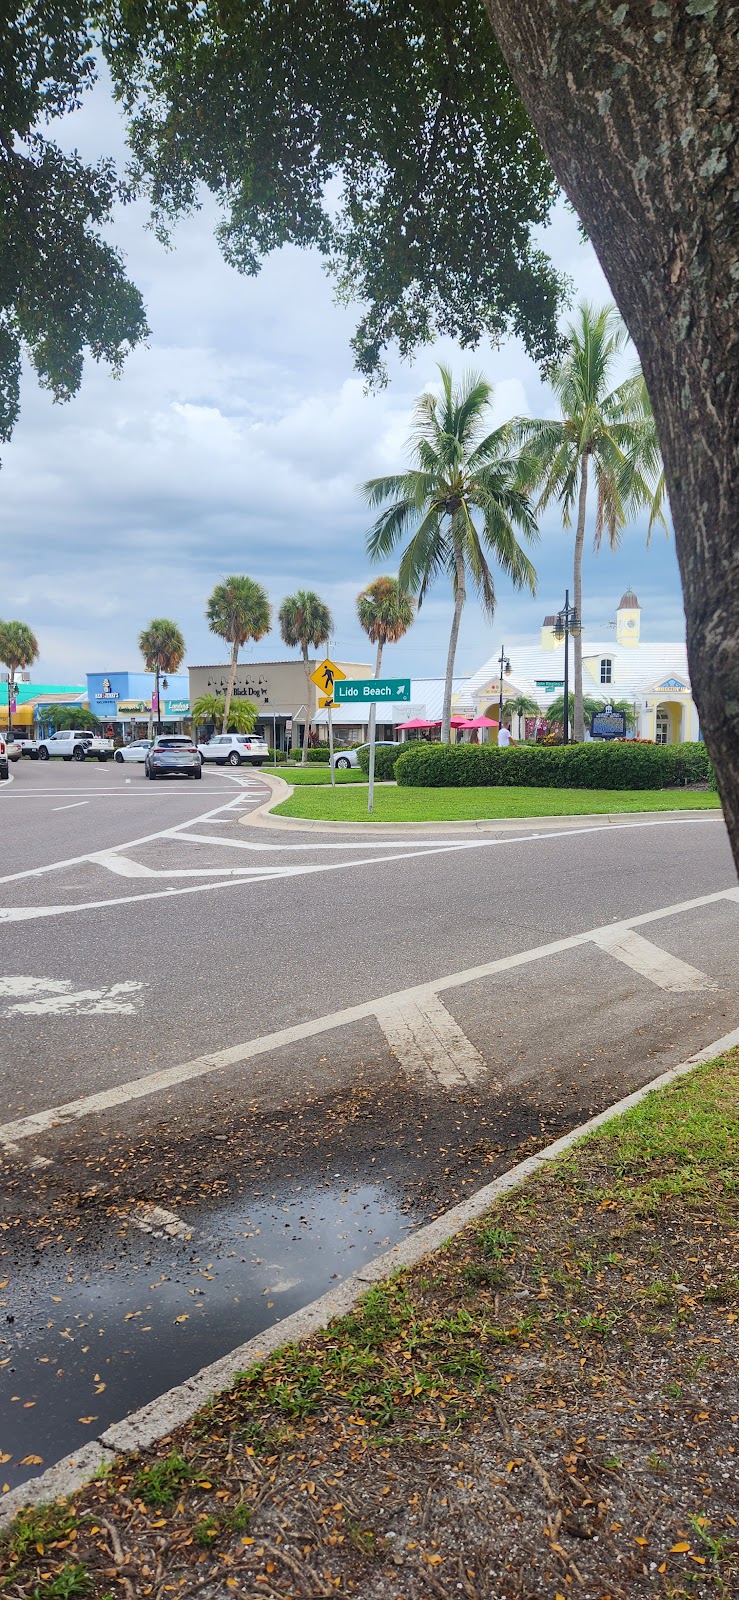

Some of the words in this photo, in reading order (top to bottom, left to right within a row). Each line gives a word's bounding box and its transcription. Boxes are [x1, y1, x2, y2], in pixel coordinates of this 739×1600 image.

[248, 688, 260, 697] Dog
[339, 687, 358, 696] Lido
[363, 686, 391, 696] Beach
